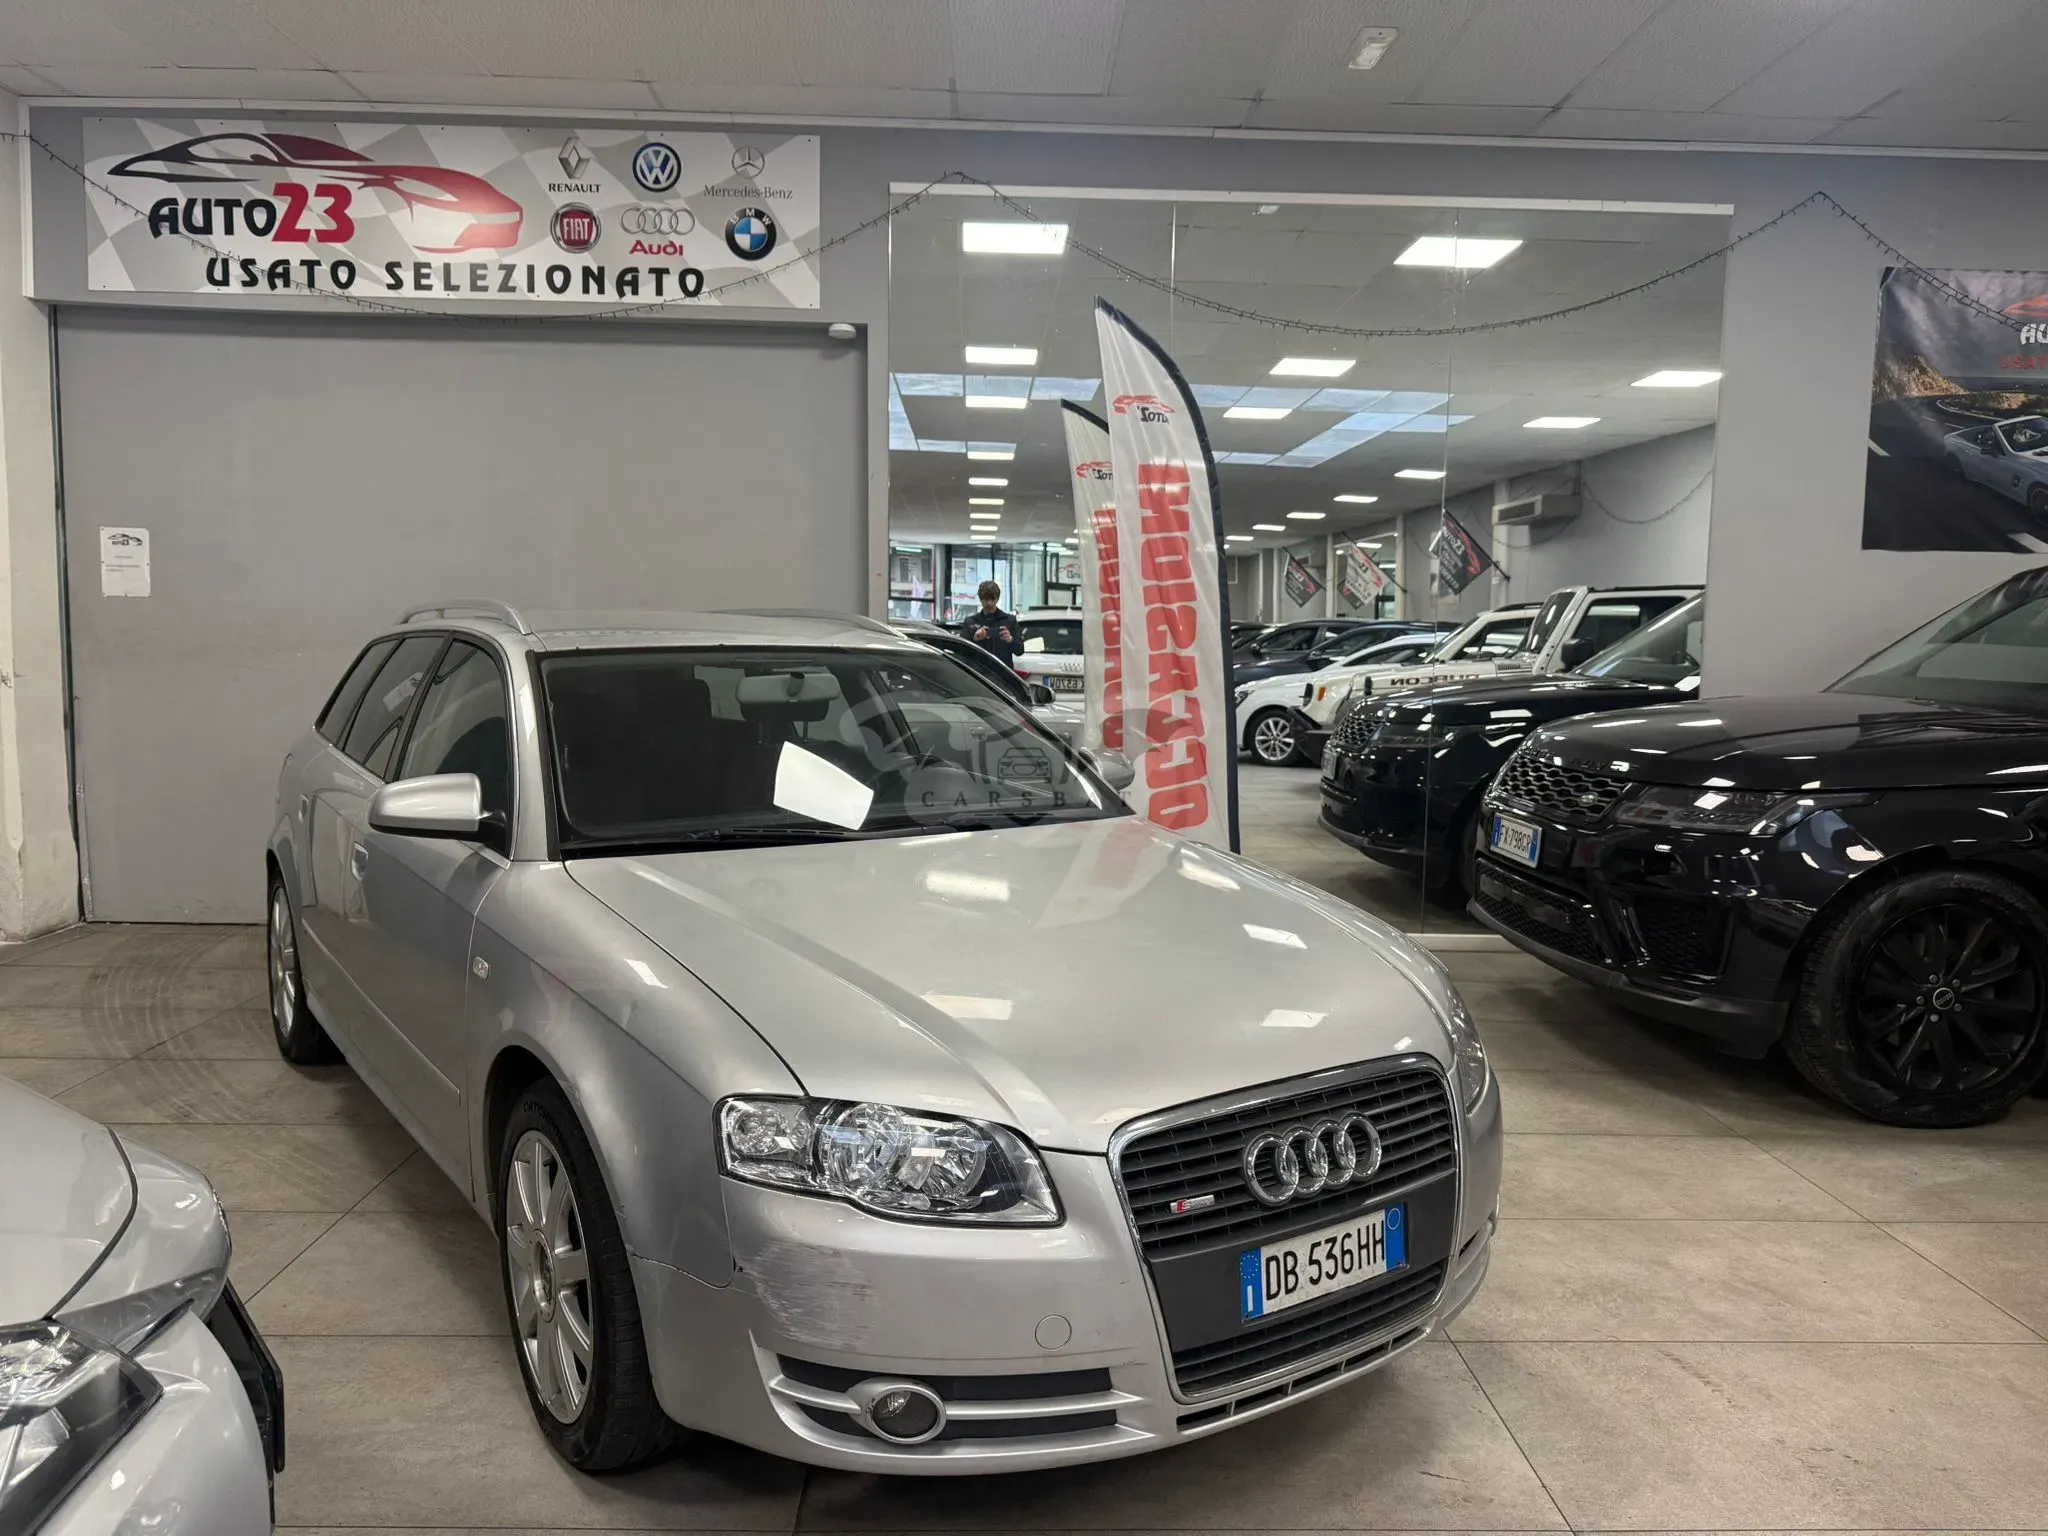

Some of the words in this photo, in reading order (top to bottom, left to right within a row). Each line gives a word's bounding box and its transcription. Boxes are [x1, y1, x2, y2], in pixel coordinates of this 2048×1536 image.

[548, 183, 601, 193] RENAULT
[703, 184, 793, 200] Mercedes-Benz
[148, 182, 355, 243] AUTO23
[729, 207, 772, 227] BMW
[563, 217, 591, 240] FIAT
[629, 239, 684, 256] Audi
[206, 257, 357, 291] USATO
[384, 261, 705, 299] SELEZIONATO
[1264, 1251, 1298, 1301] DB
[1307, 1219, 1385, 1285] 536HH
